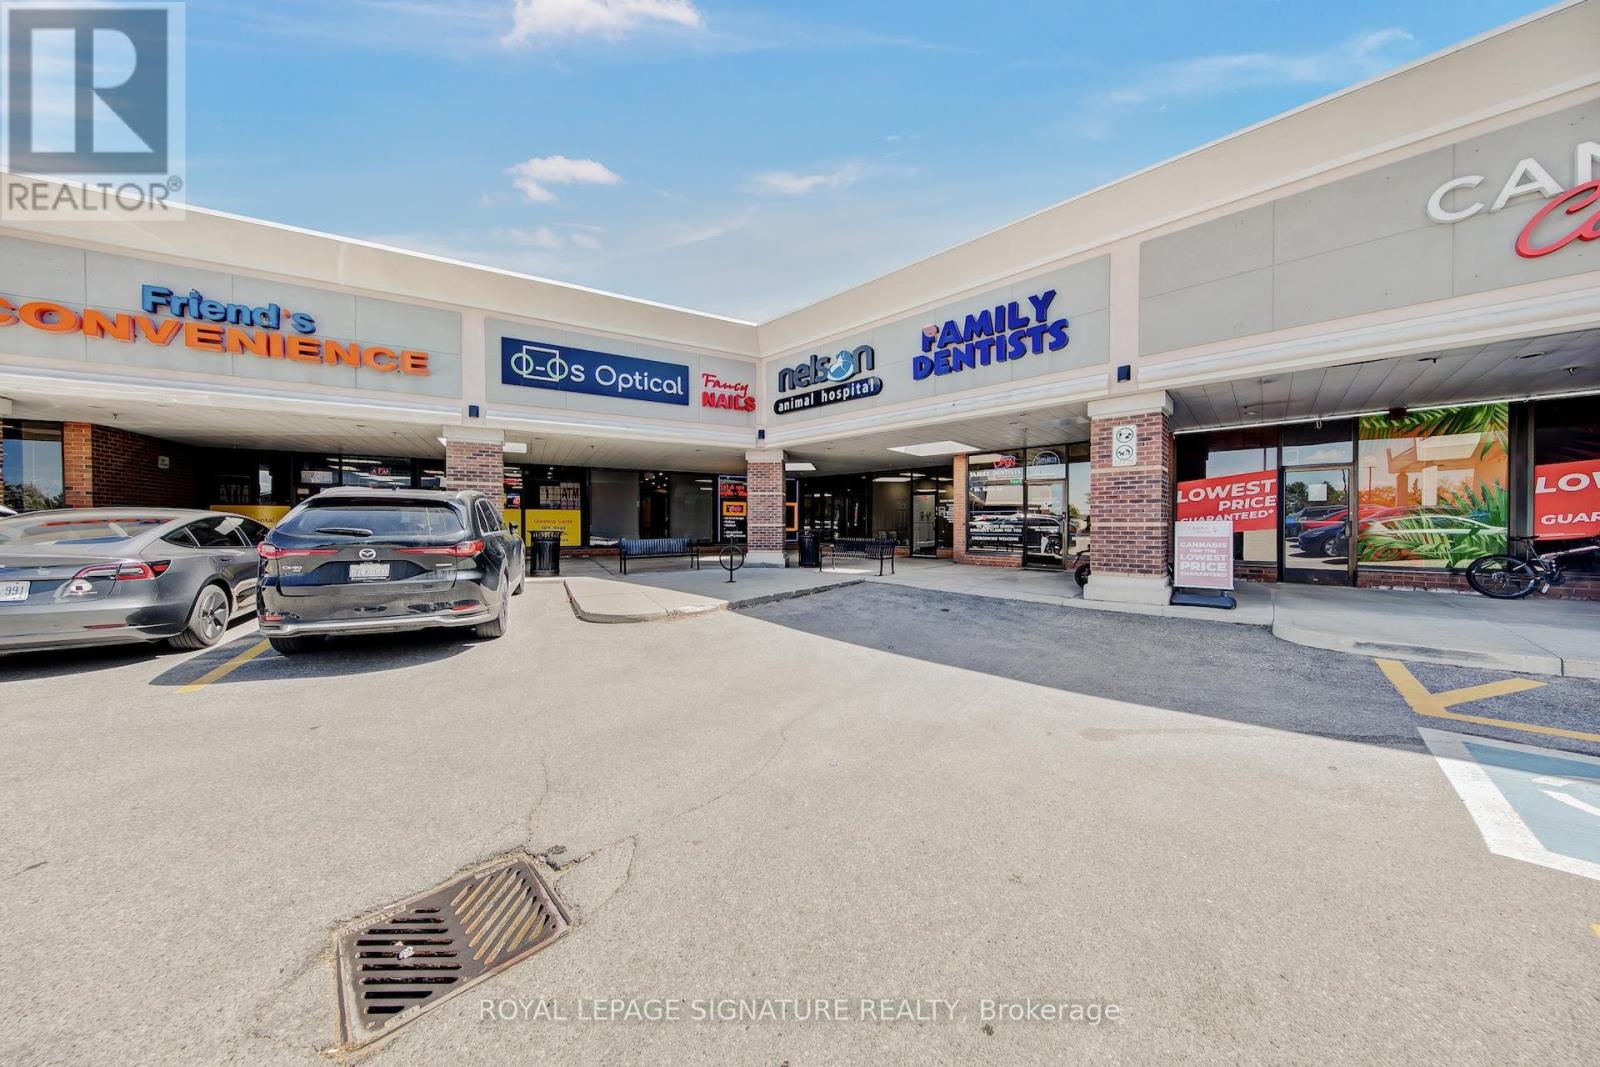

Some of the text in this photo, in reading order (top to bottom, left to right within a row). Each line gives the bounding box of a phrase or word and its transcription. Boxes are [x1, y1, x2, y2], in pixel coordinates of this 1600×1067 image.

[1427, 141, 1600, 224] CA
[141, 284, 317, 334] Friend's
[922, 289, 1057, 353] FAMILY
[912, 318, 1070, 381] DENTISTS
[595, 365, 684, 397] Optical
[778, 344, 875, 393] nelson
[702, 373, 749, 398] Fancy
[778, 378, 875, 413] animal hospital
[702, 391, 756, 413] NAILS
[1177, 479, 1277, 503] LOWEST
[1535, 471, 1600, 494] LO
[1219, 495, 1277, 512] PRICE
[1180, 561, 1227, 572] PRICE
